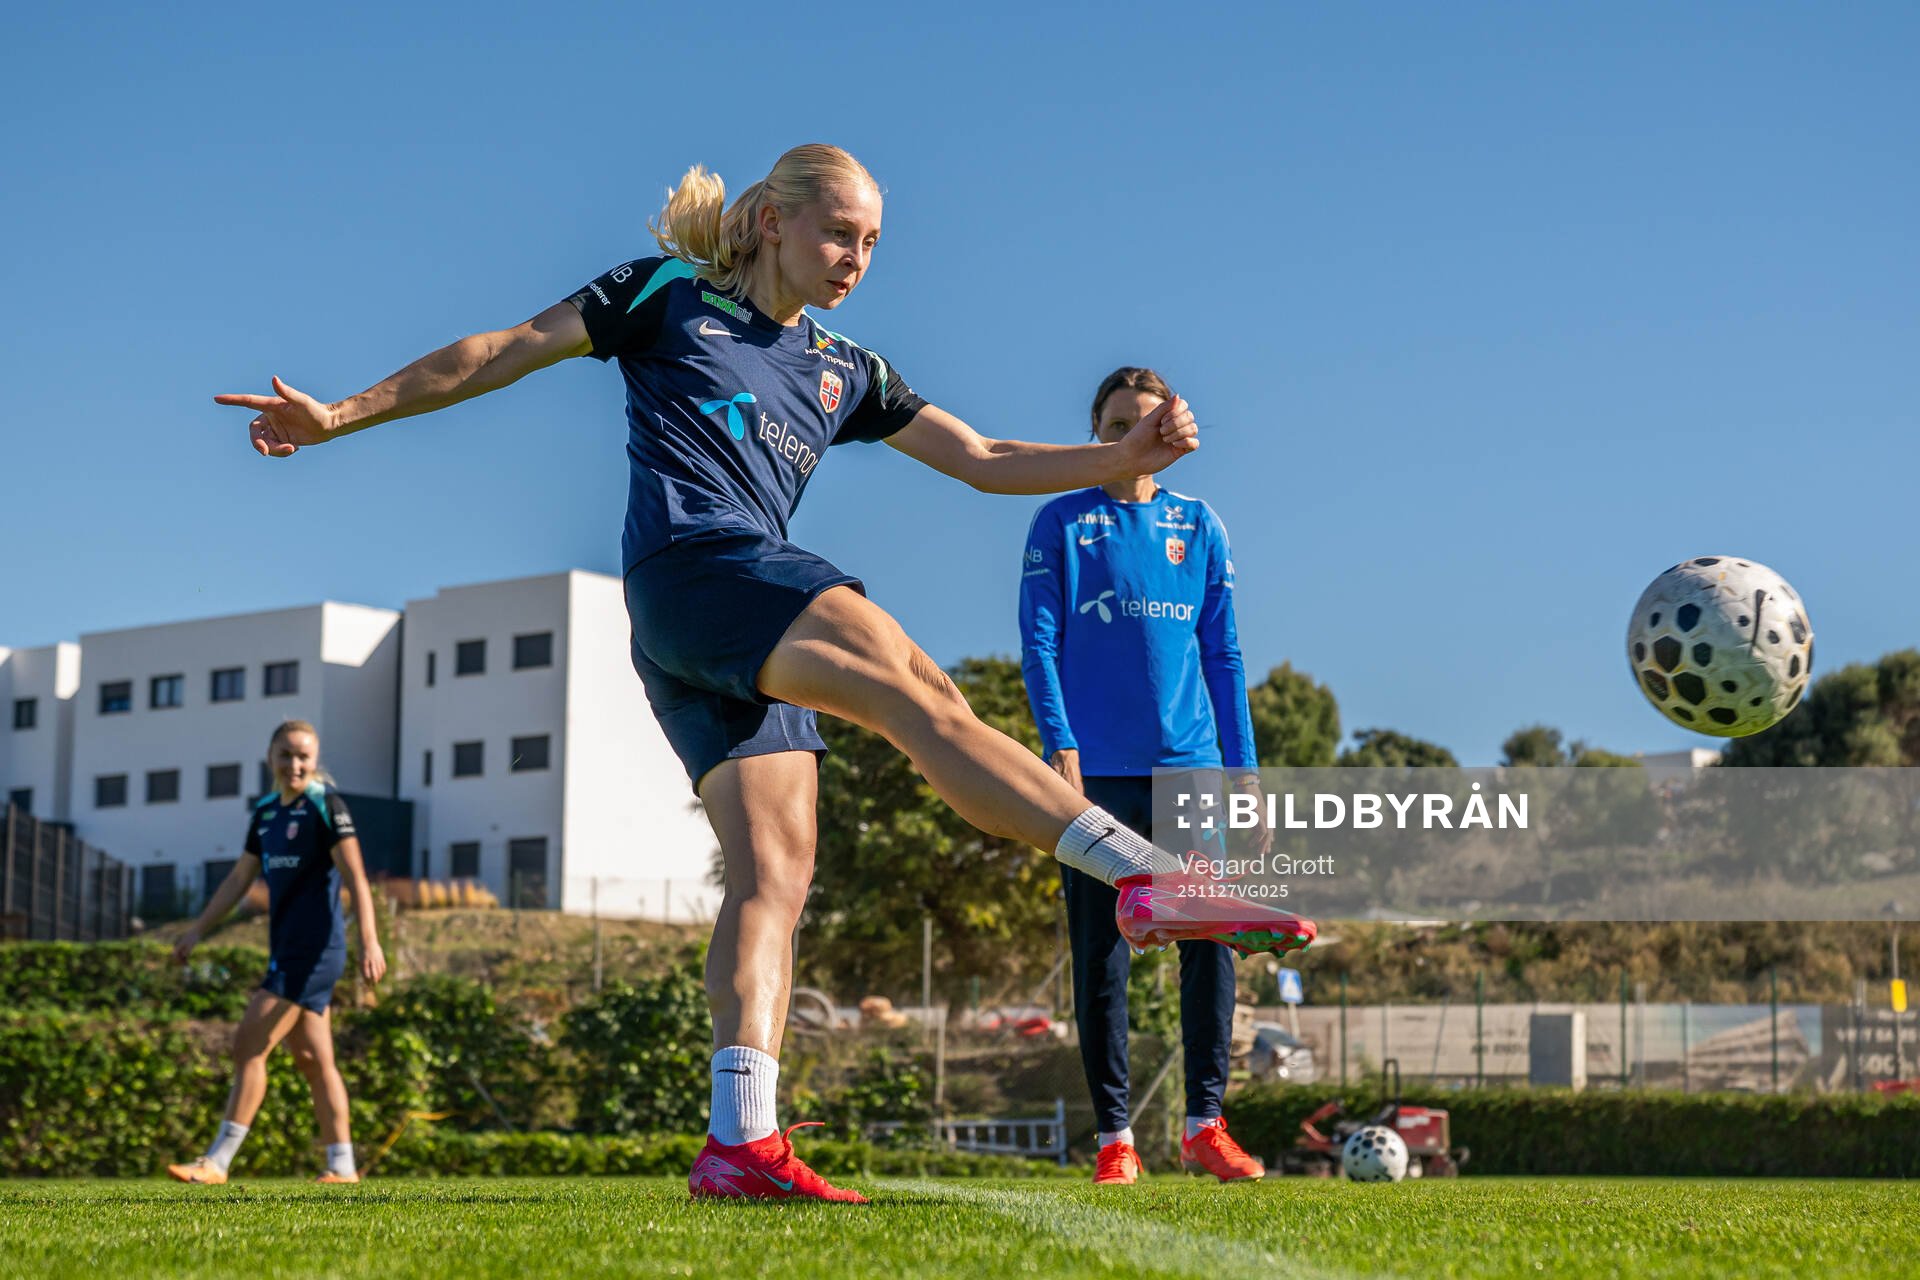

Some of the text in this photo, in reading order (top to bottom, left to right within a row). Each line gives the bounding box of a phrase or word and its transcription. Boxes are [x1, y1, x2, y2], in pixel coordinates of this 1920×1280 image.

[610, 261, 633, 283] NB
[589, 283, 611, 306] esterer
[701, 290, 738, 318] KIWI
[758, 411, 819, 478] telenor
[1121, 596, 1195, 622] telenor
